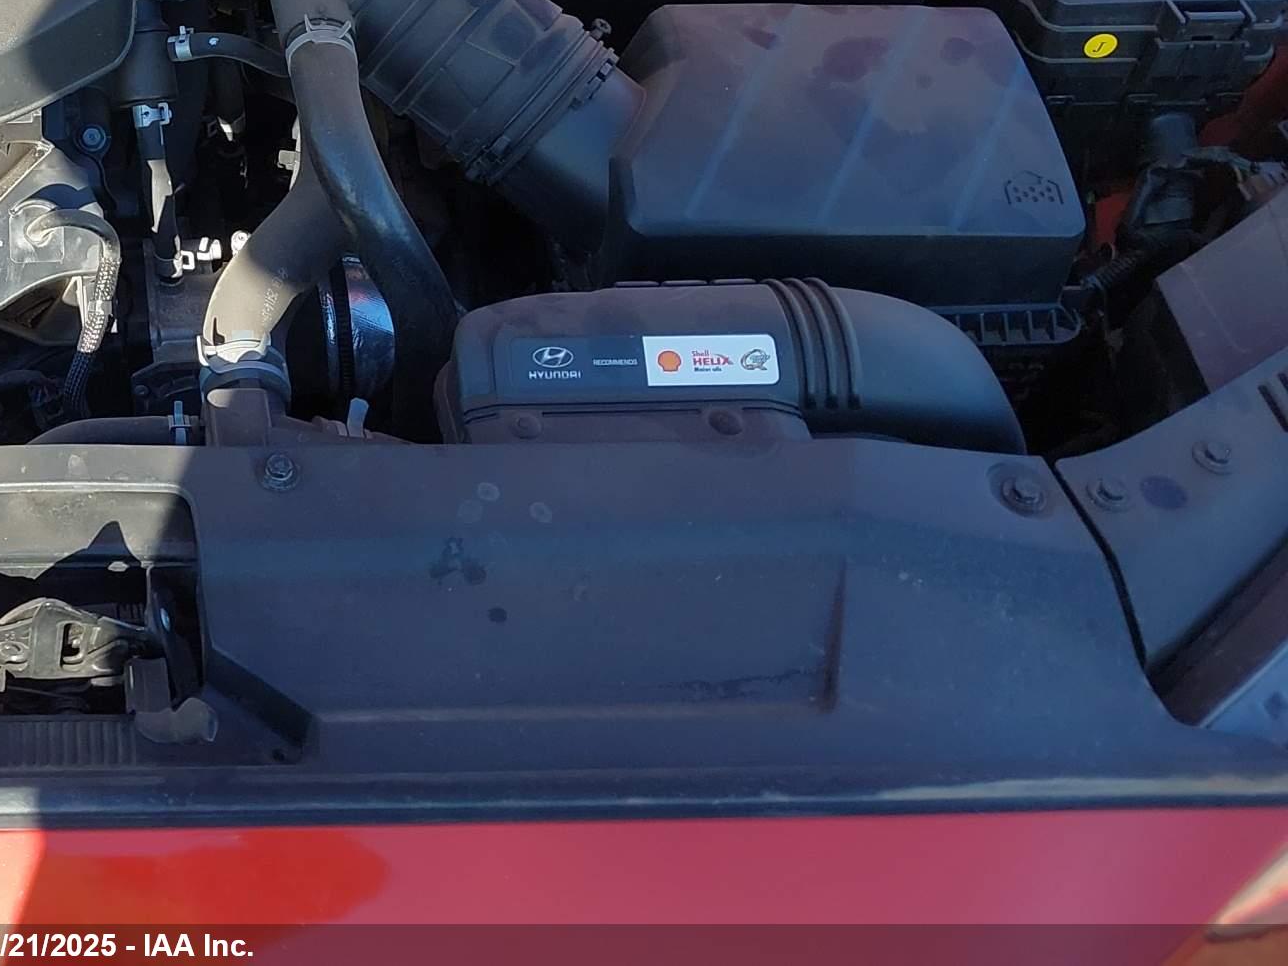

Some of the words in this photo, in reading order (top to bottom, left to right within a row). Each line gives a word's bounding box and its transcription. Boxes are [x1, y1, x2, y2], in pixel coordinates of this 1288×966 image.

[593, 358, 638, 366] RECOMMENDS
[693, 356, 733, 366] HELIX
[529, 370, 582, 380] HYUNDAI
